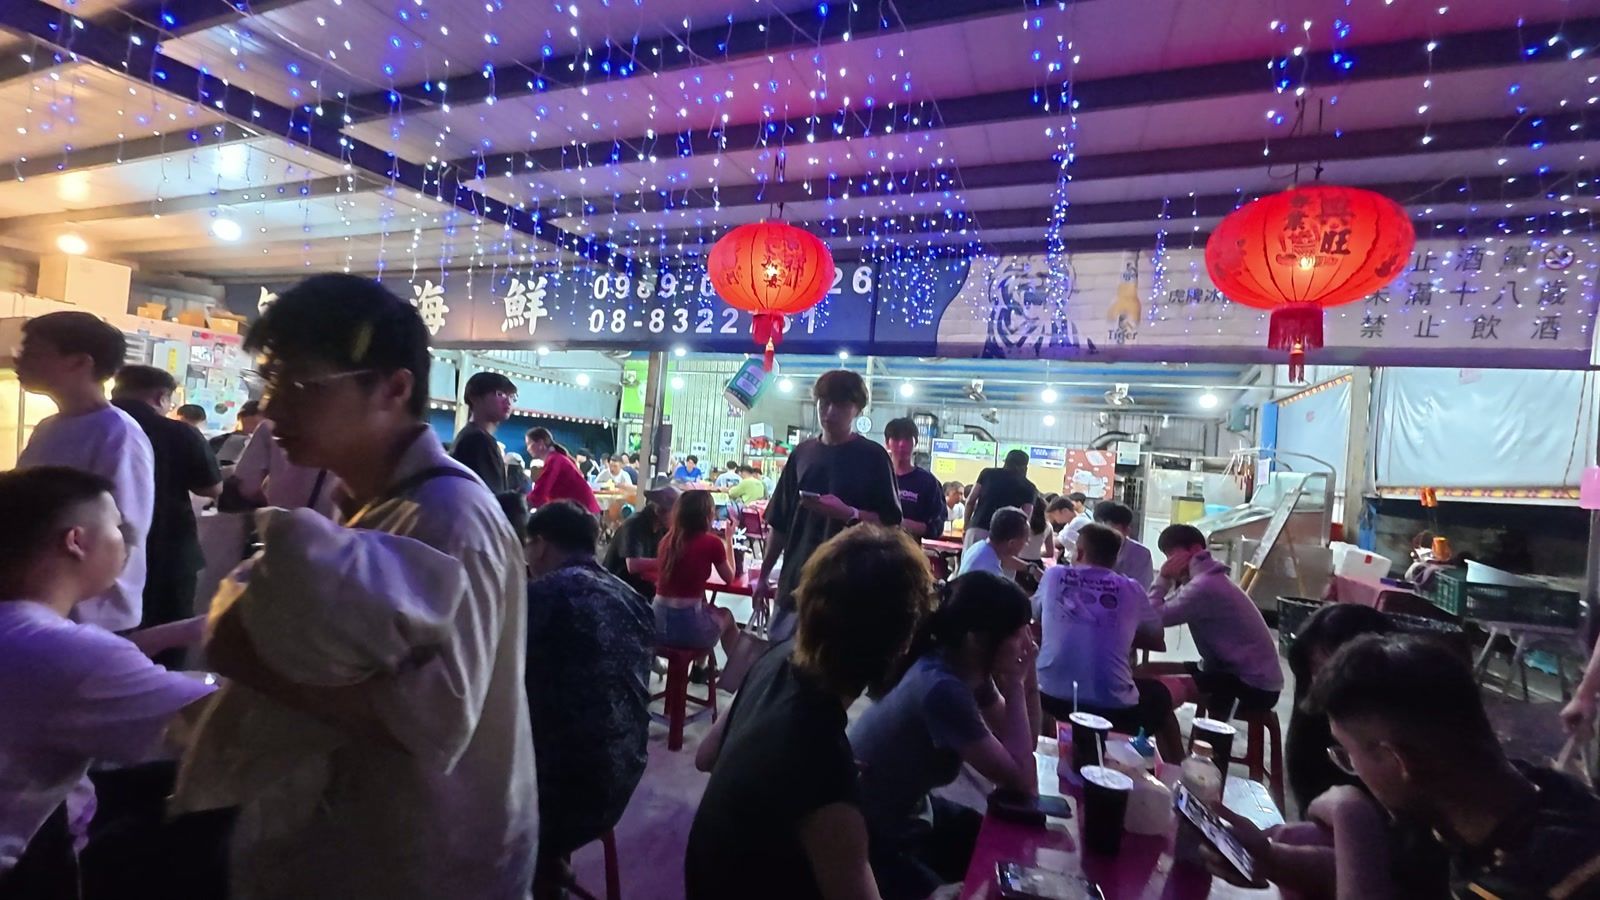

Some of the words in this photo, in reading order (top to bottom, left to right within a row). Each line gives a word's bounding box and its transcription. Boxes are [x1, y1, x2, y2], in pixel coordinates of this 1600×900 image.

[1168, 289, 1228, 304] 虎牌冰
[1108, 327, 1138, 345] Tiger
[1361, 313, 1562, 341] 禁止飲酒
